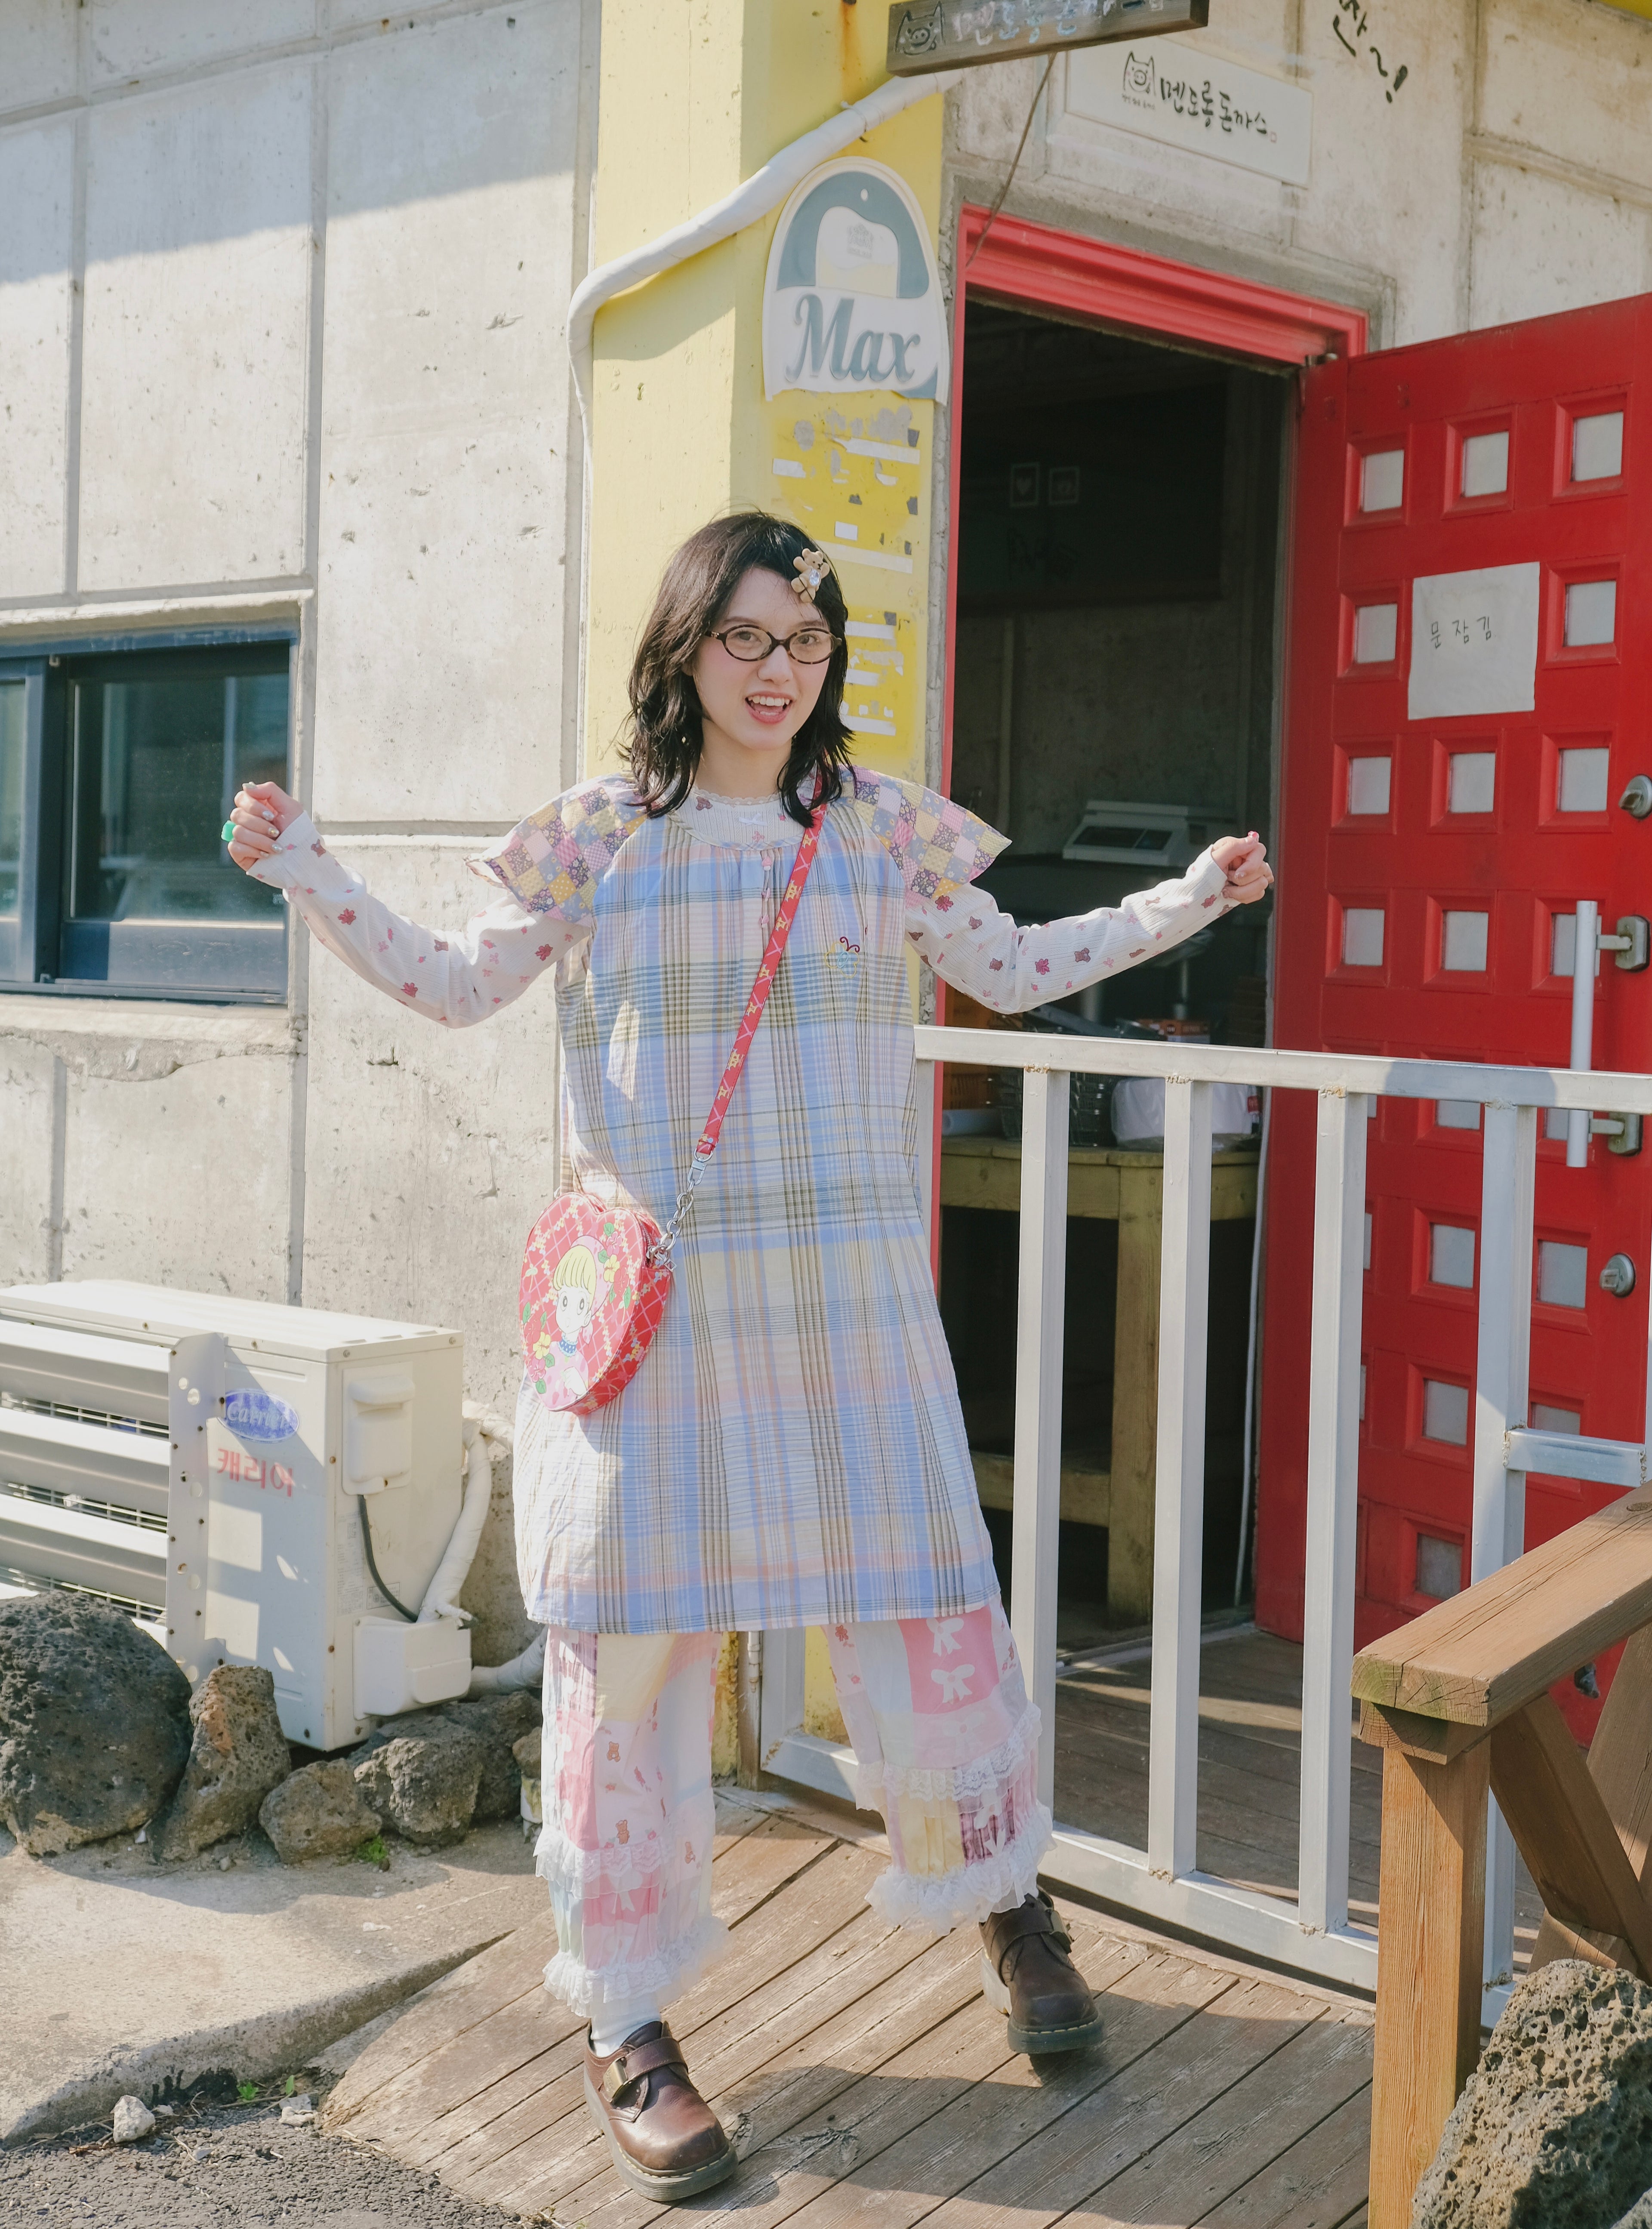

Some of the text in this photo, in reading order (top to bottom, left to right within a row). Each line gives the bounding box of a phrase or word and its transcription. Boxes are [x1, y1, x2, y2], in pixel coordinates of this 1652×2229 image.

[1160, 77, 1267, 135] 멘도롱돈까스
[785, 293, 921, 382] Max
[227, 1401, 287, 1429] Carrier
[217, 1448, 294, 1498] 캐리어
